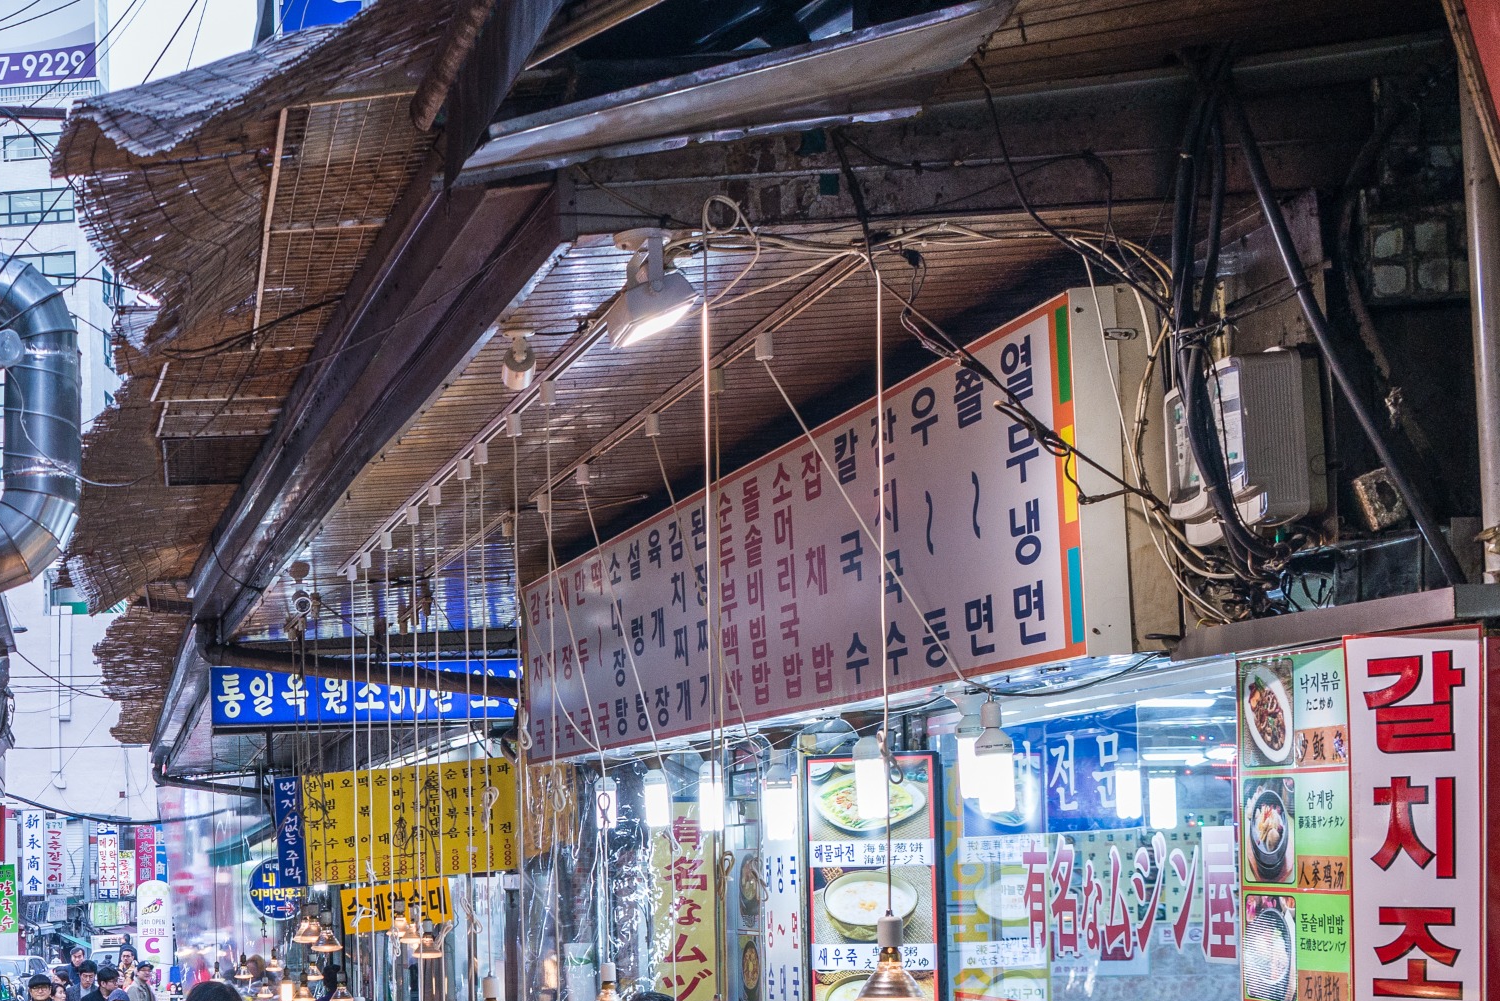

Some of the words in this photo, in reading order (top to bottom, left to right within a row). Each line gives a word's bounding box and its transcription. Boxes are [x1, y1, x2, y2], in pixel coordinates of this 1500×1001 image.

[1001, 334, 1046, 646] 열무냉면
[742, 476, 770, 706] 돌솥비빔밥
[772, 462, 803, 699] 소머리국밥
[801, 450, 833, 694] 잡채밥
[834, 428, 869, 685] 칼국수
[648, 529, 669, 727] 육개장
[669, 517, 691, 721] 김치찌개
[717, 492, 742, 711] 순두부백반
[531, 590, 546, 751] 감자국
[609, 553, 627, 735] 소내장탕
[217, 673, 306, 719] 통일옥
[1300, 670, 1342, 694] 낙지볶음
[341, 778, 354, 848] 오뎅
[374, 775, 390, 845] 순대
[445, 768, 461, 838] 순대볶음
[497, 762, 512, 833] 파전
[1306, 789, 1335, 810] 삼계탕
[25, 814, 42, 892] 新永商會
[99, 838, 108, 888] 메밀국수
[108, 836, 118, 887] 가락국수
[815, 843, 855, 863] 해물파전
[98, 889, 119, 899] 전문
[265, 905, 275, 914] 2F
[1021, 832, 1237, 960] 有名なムジン屋
[1300, 913, 1345, 935] 돌솥비빔밥
[142, 927, 166, 936] 편의점
[818, 948, 858, 967] 새우죽
[864, 957, 930, 970] えかゆ
